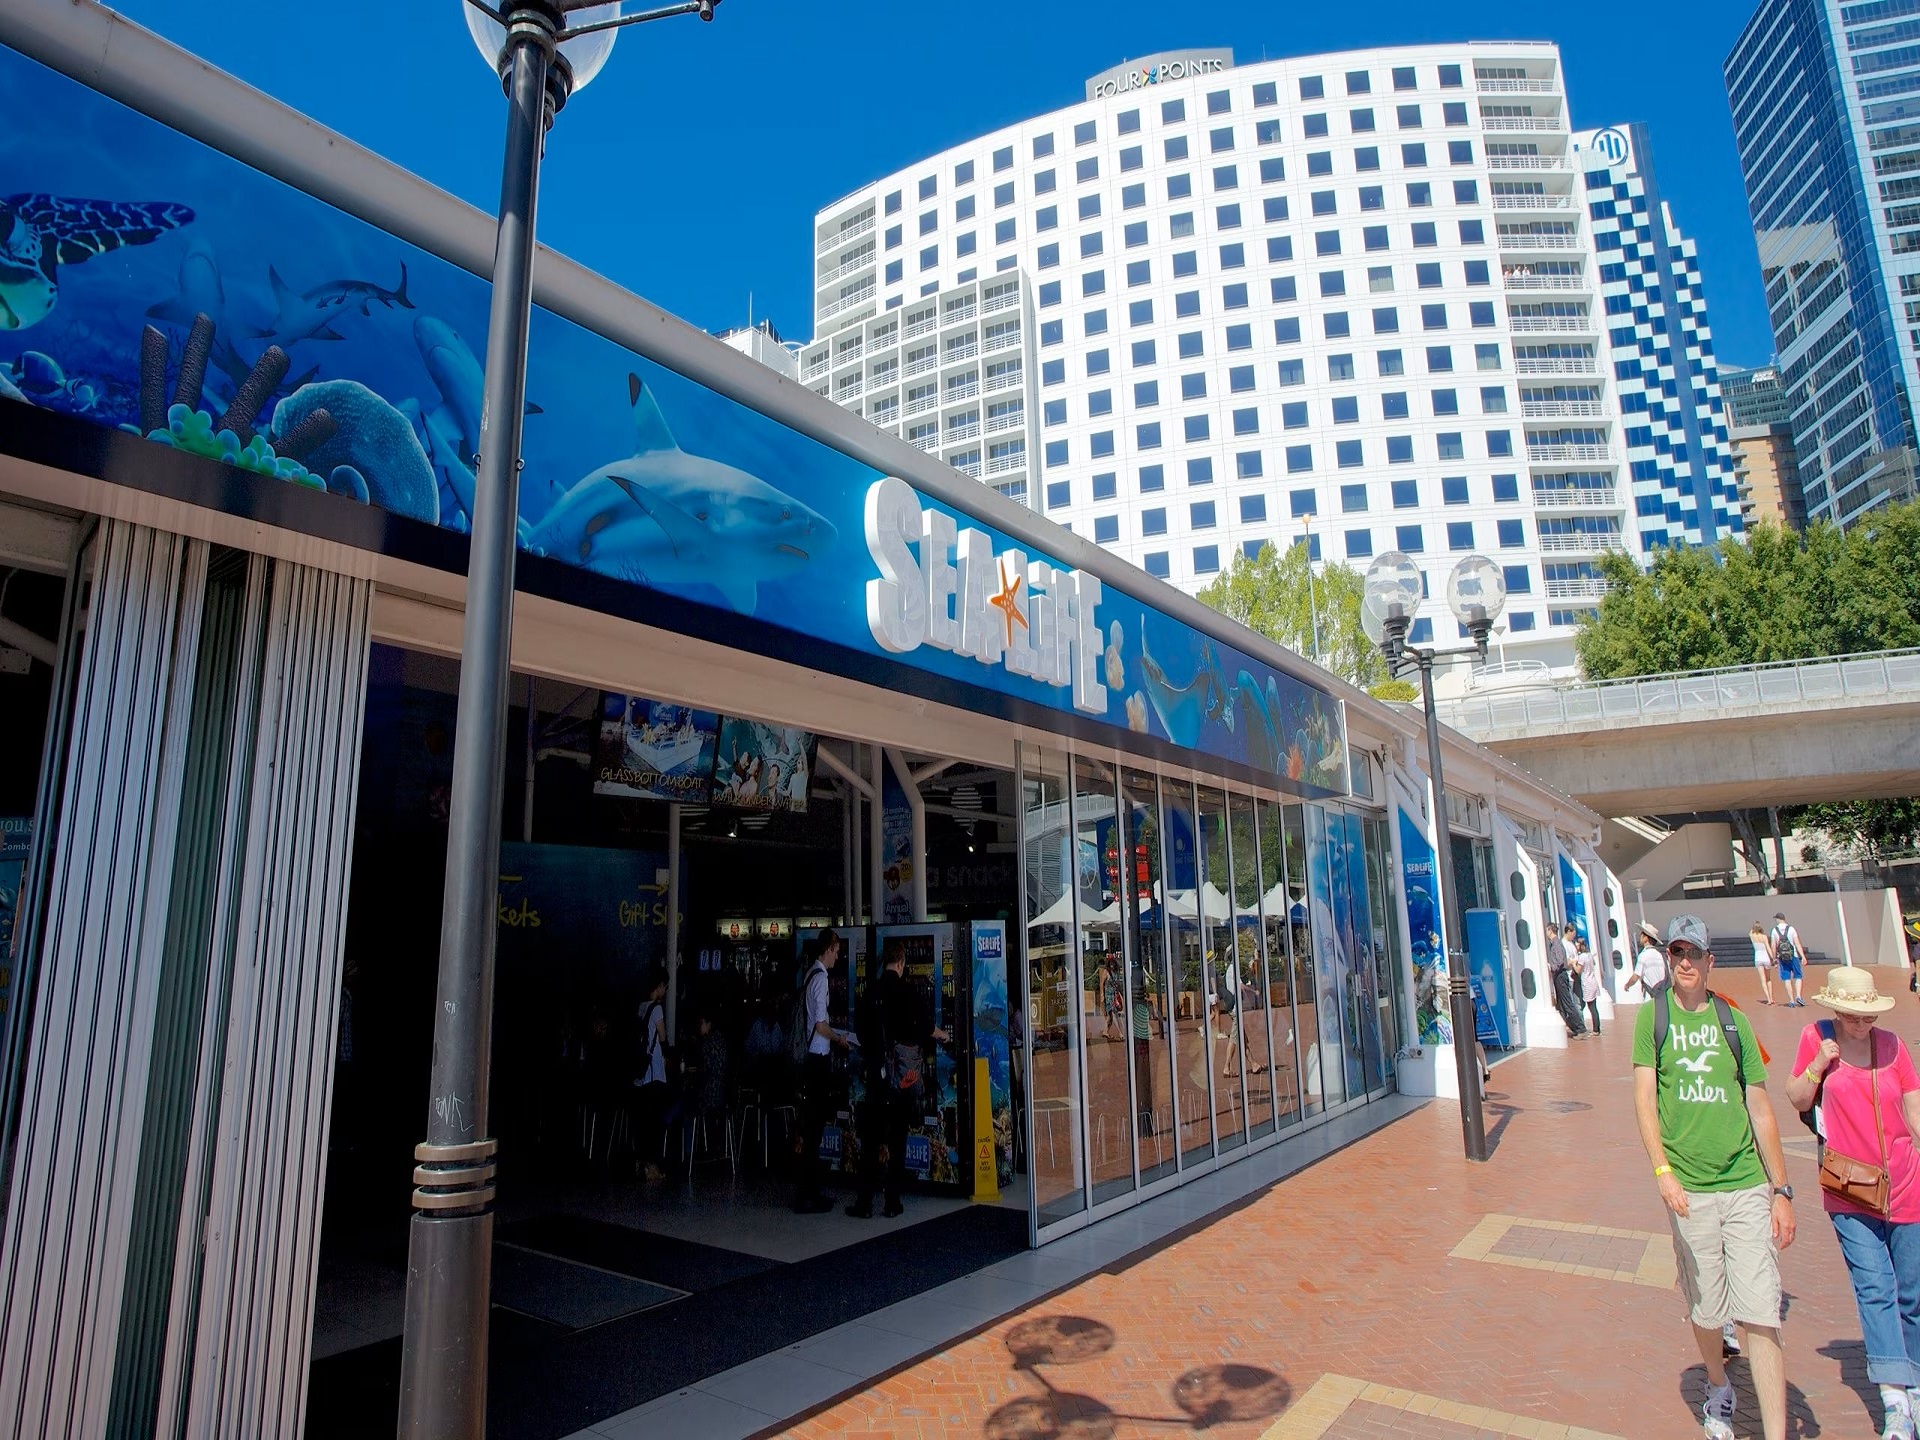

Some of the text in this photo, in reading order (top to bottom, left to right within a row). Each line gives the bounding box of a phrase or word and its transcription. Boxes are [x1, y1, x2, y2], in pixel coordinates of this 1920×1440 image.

[1094, 58, 1223, 100] FOUR POINTS
[864, 477, 1002, 664] SEA
[601, 766, 704, 790] GLASS BOTTOM BOAT
[619, 899, 683, 934] Gift Sp
[977, 935, 990, 952] SEA
[1669, 1023, 1720, 1051] Holl
[1678, 1074, 1728, 1104] ister
